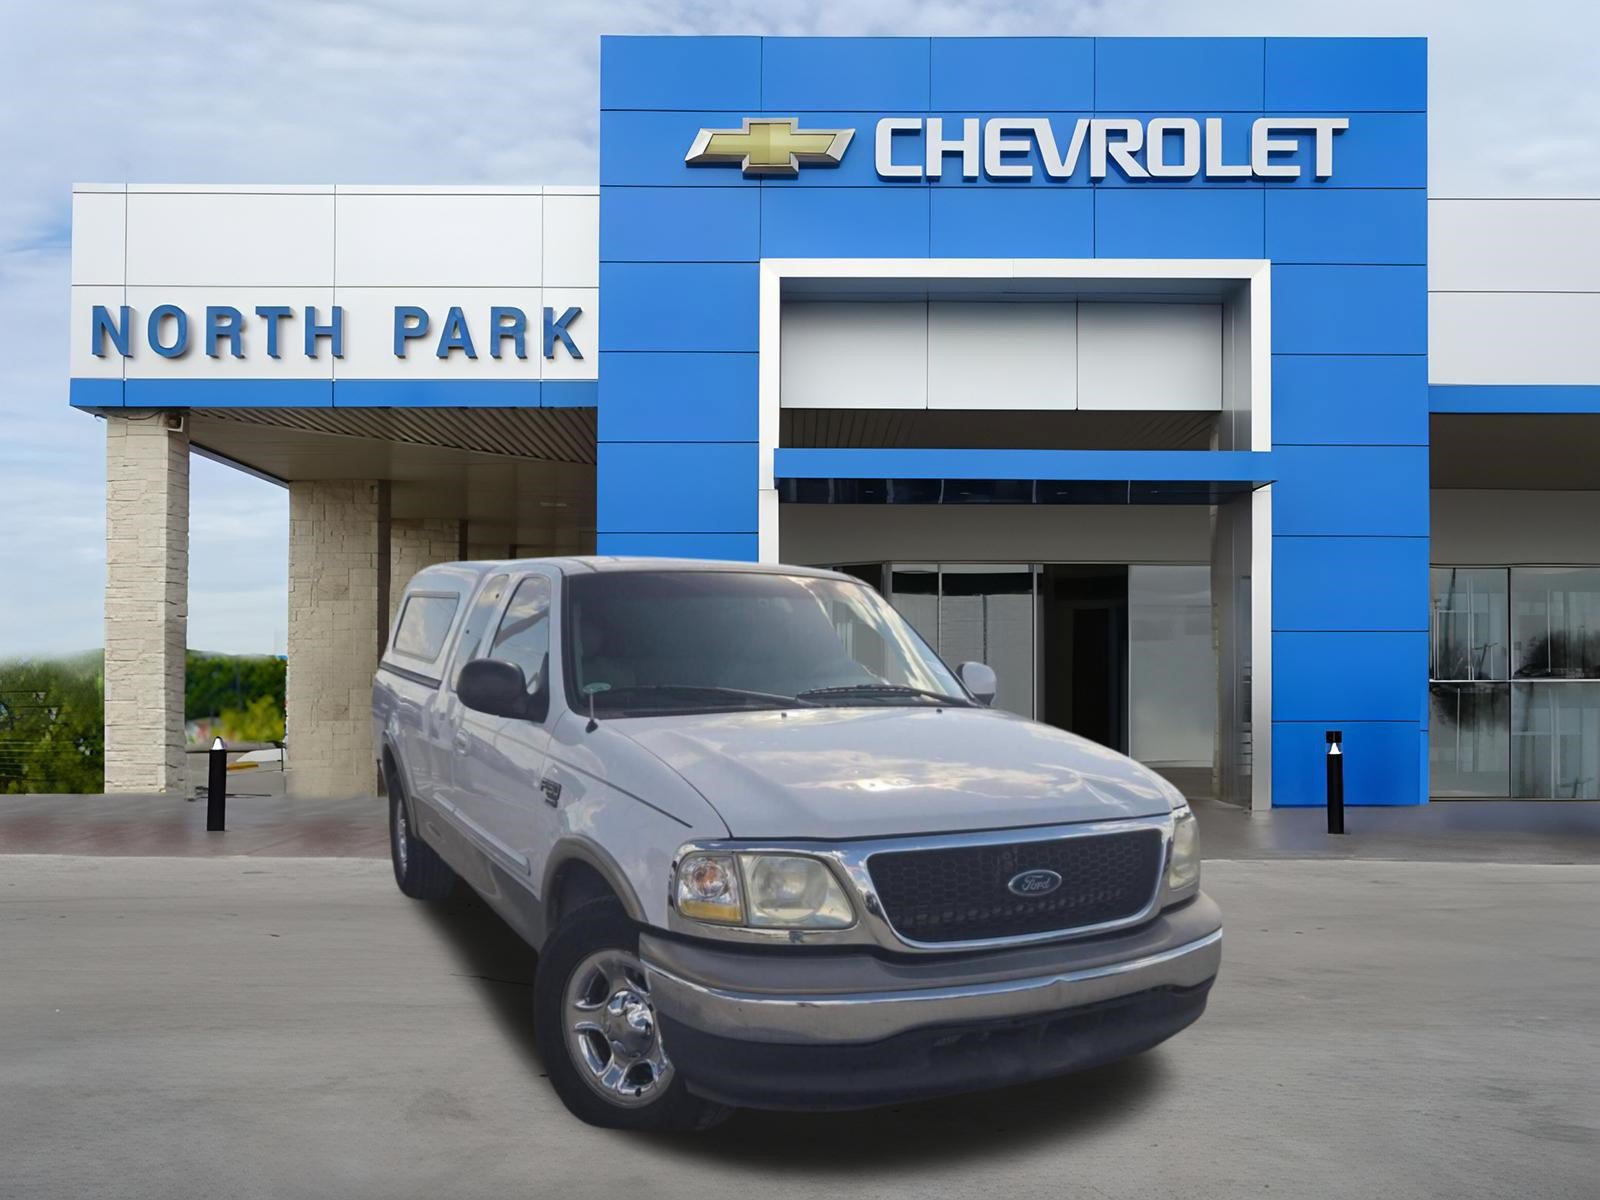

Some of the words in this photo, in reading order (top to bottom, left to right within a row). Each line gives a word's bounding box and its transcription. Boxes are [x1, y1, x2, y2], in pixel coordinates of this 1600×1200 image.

[875, 117, 1350, 180] CHEVROLET
[92, 304, 346, 359] NORTH
[394, 305, 584, 360] PARK
[1022, 874, 1051, 891] Ford
